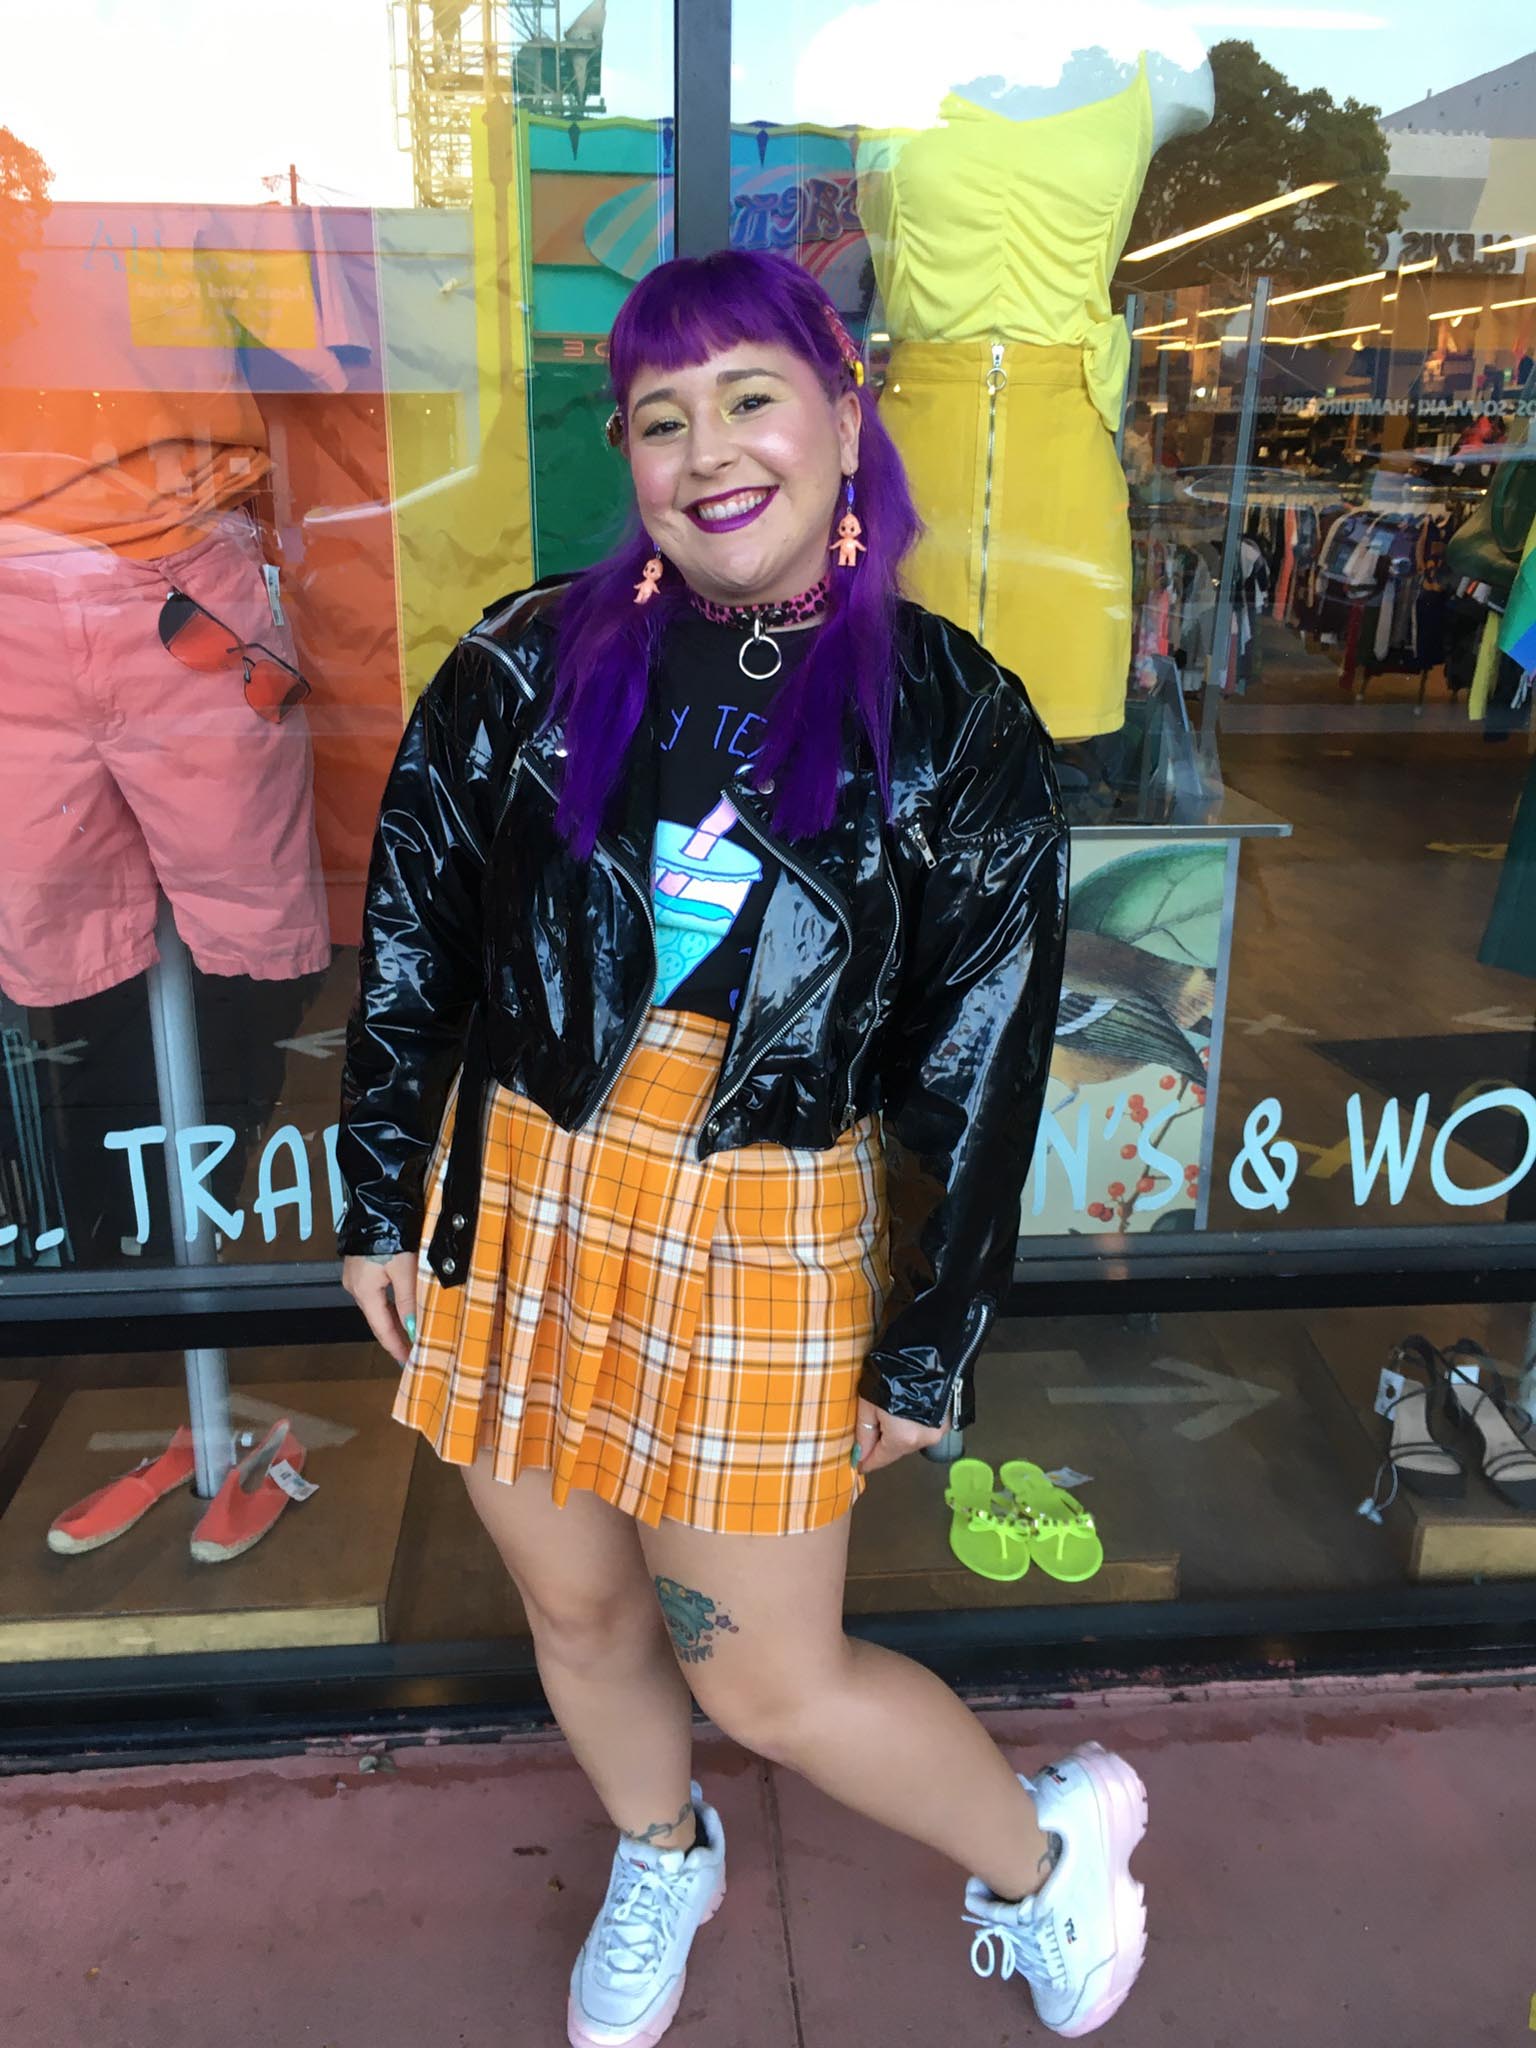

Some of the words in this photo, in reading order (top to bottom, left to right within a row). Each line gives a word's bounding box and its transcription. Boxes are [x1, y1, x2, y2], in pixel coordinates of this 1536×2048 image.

[104, 1125, 345, 1244] TRA
[1229, 1098, 1298, 1213] &
[1346, 1088, 1536, 1207] WO
